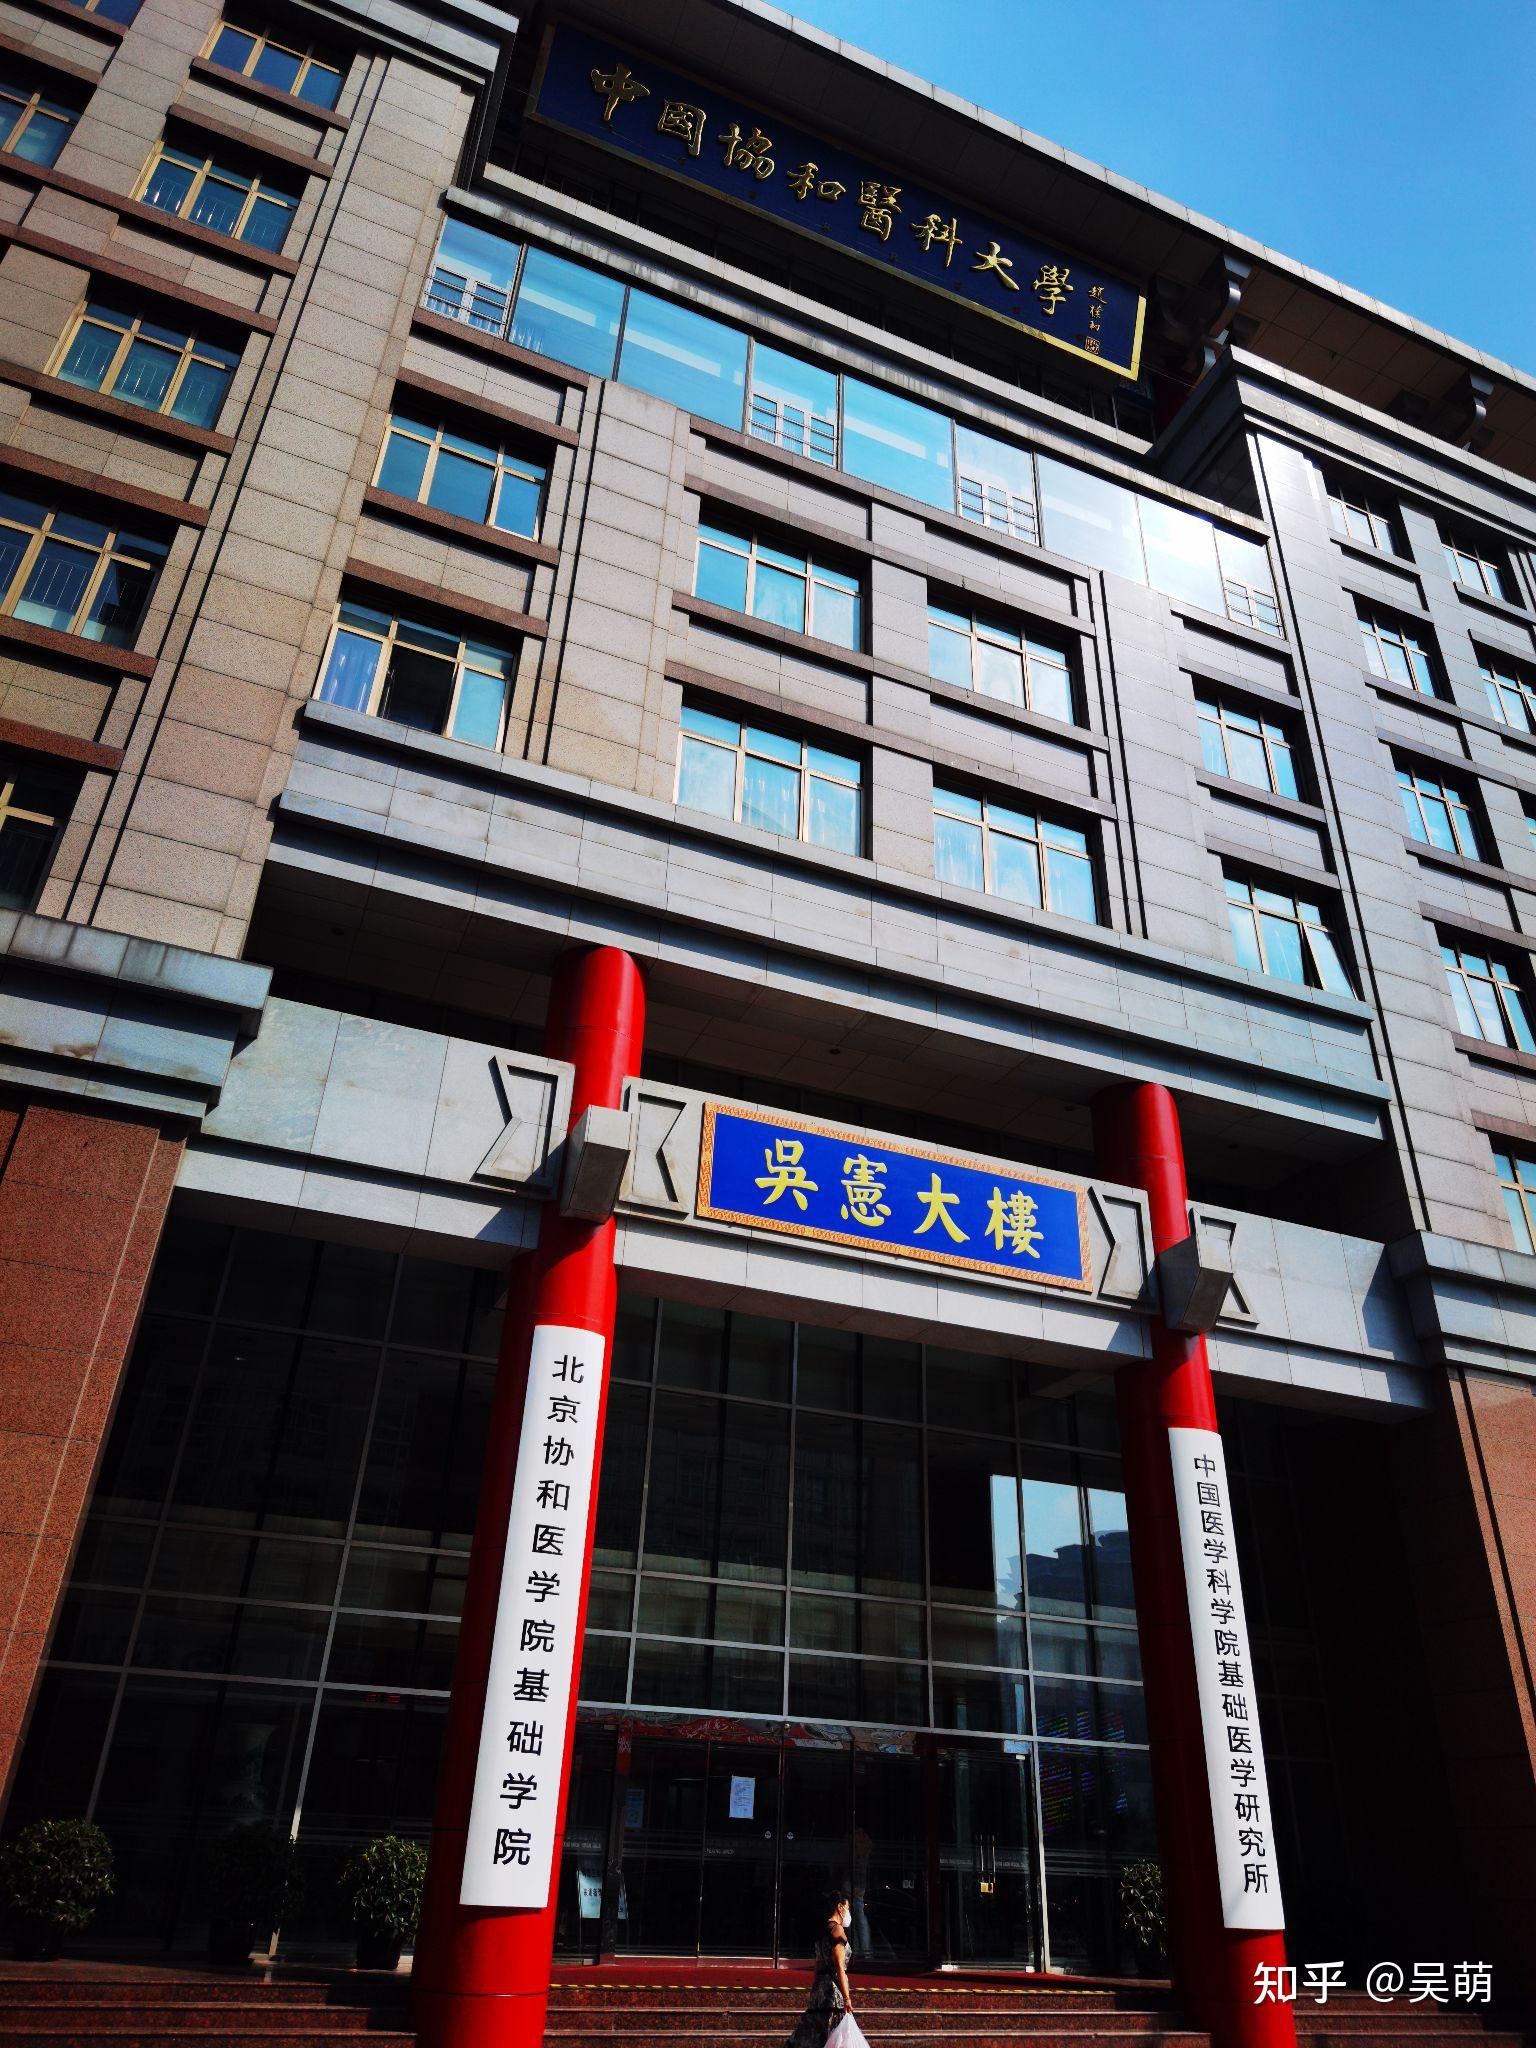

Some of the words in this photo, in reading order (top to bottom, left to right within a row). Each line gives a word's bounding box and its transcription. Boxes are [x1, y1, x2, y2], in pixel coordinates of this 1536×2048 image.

[590, 62, 1075, 316] 中國協和醫科大學
[754, 1138, 1045, 1259] 吳憲大樓
[491, 1353, 585, 1866] 北京协和医学院基础学院
[1193, 1453, 1269, 1894] 中国医学科学院基础医学研究所
